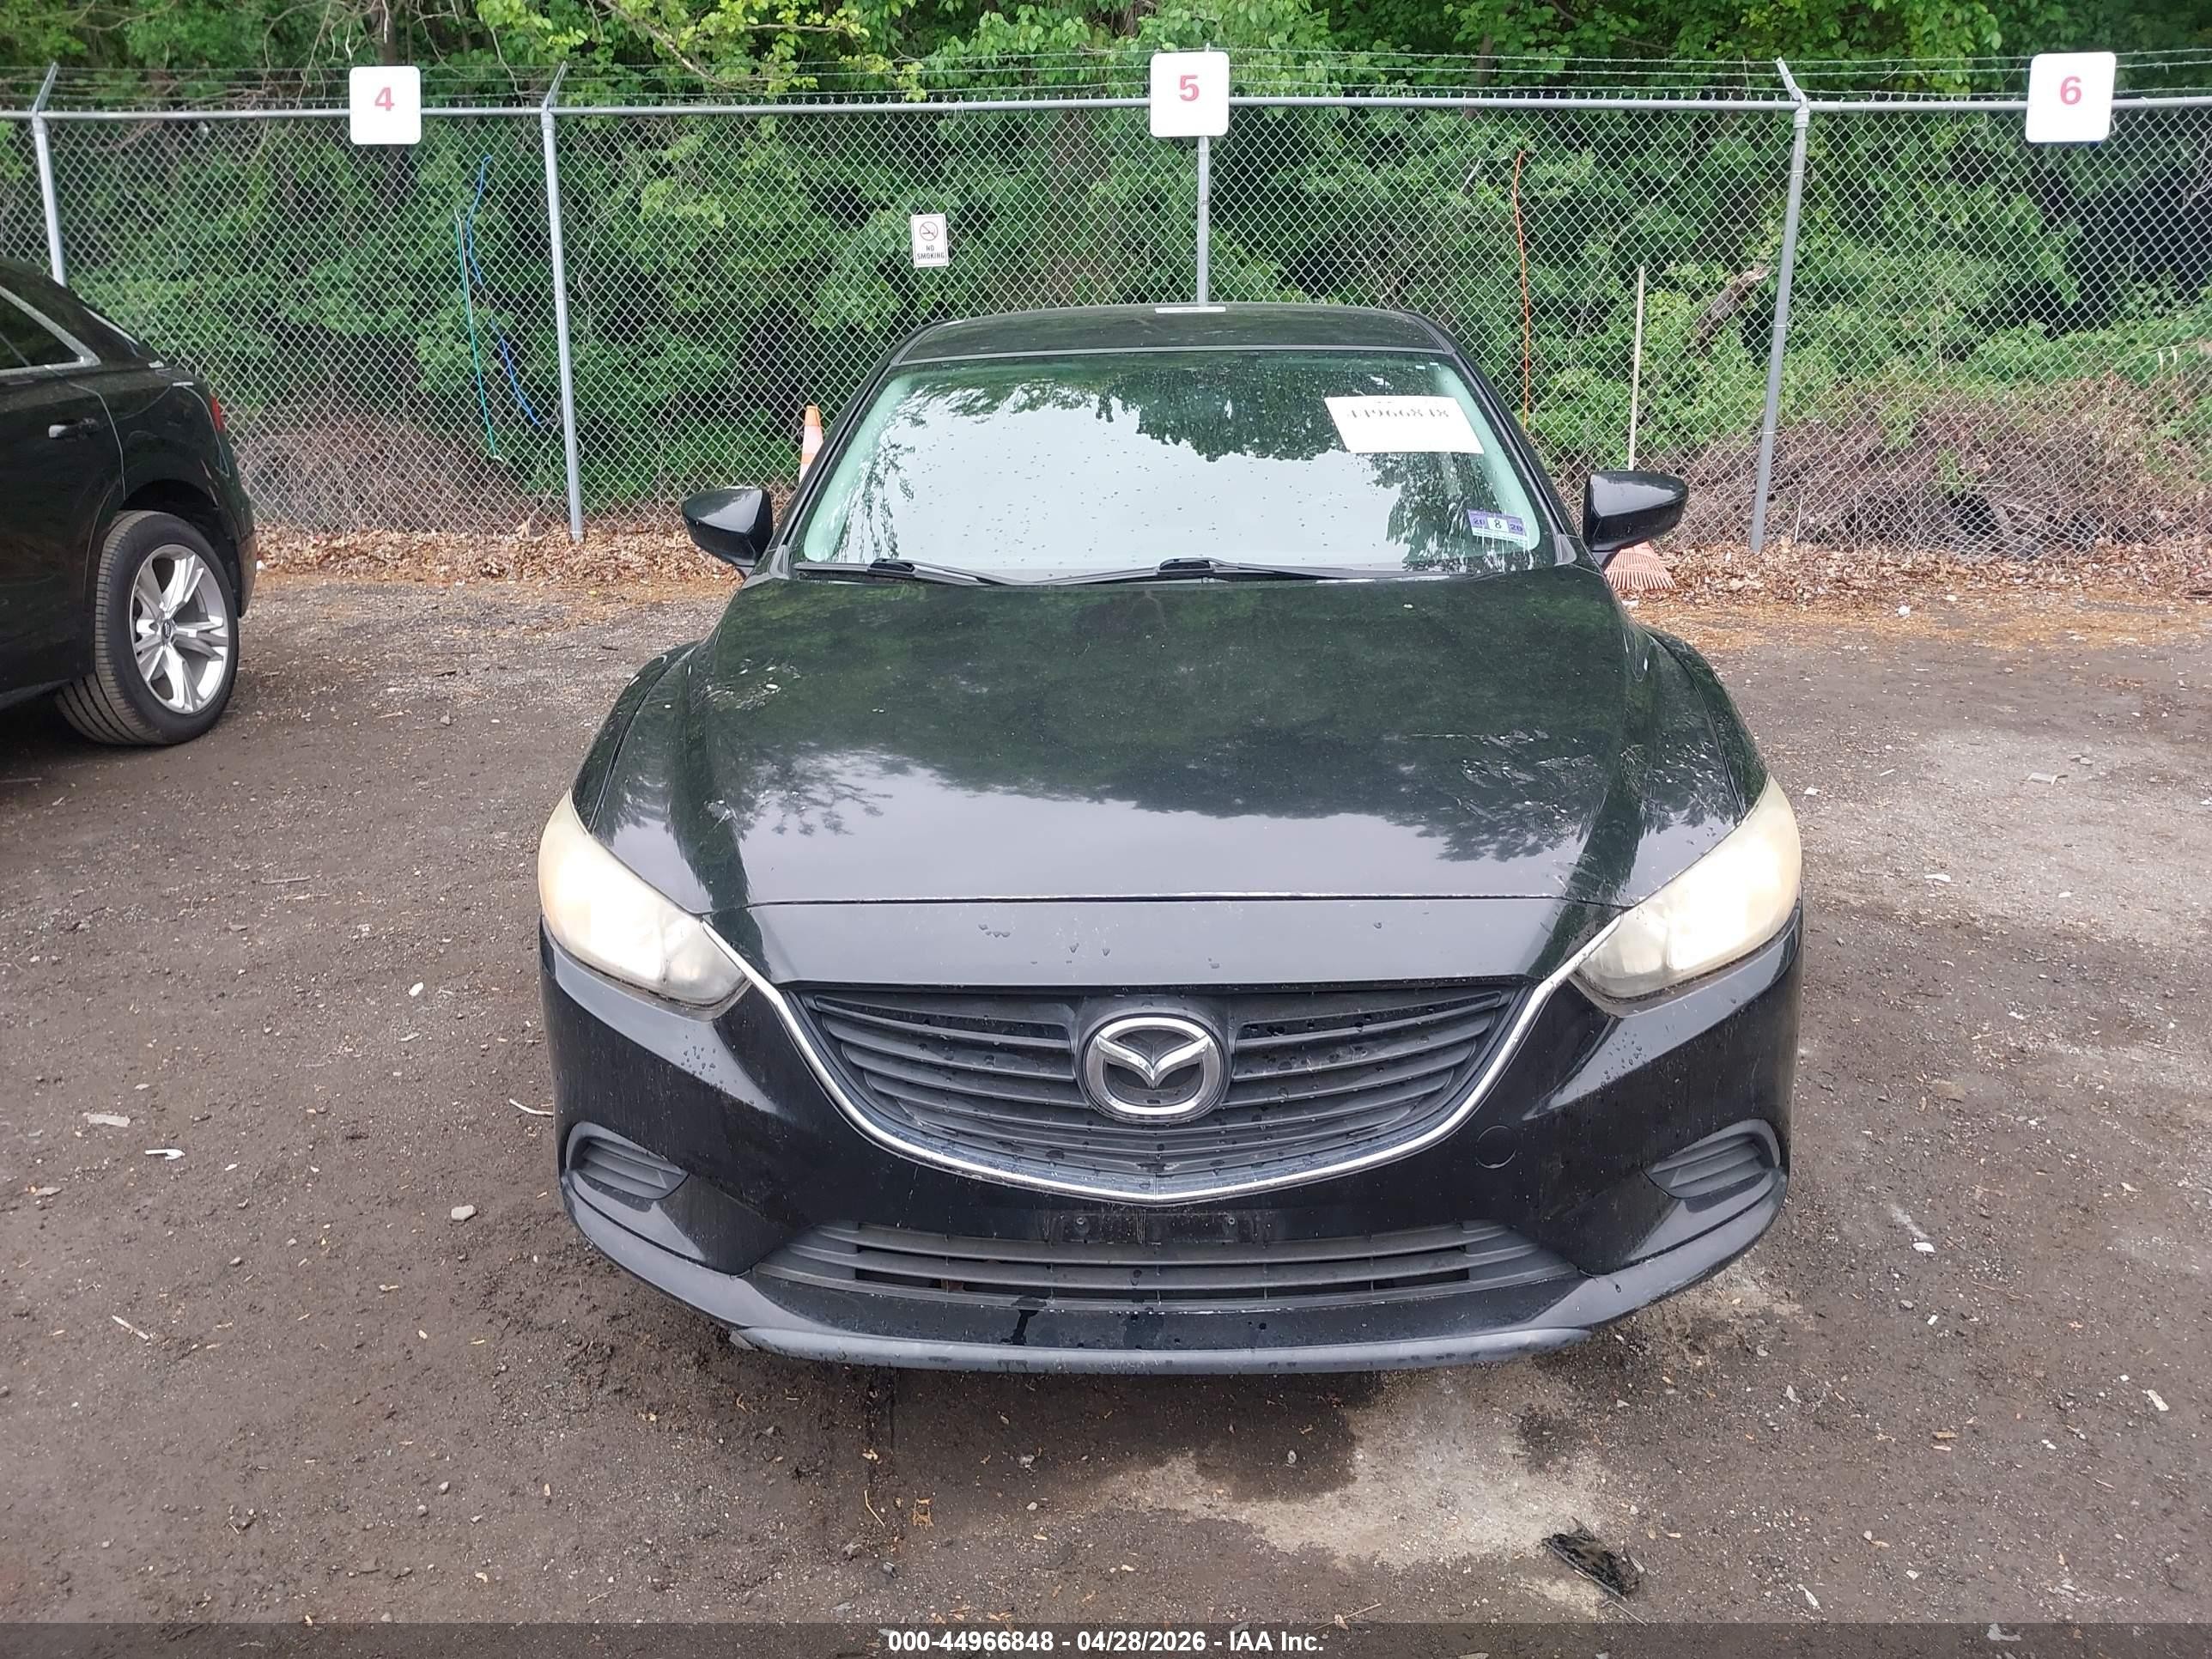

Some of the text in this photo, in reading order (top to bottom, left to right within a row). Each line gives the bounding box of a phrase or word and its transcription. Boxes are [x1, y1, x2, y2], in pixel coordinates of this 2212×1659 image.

[374, 87, 395, 111] 4
[1179, 75, 1200, 101] 5
[2059, 76, 2082, 105] 6
[1493, 519, 1502, 529] 8
